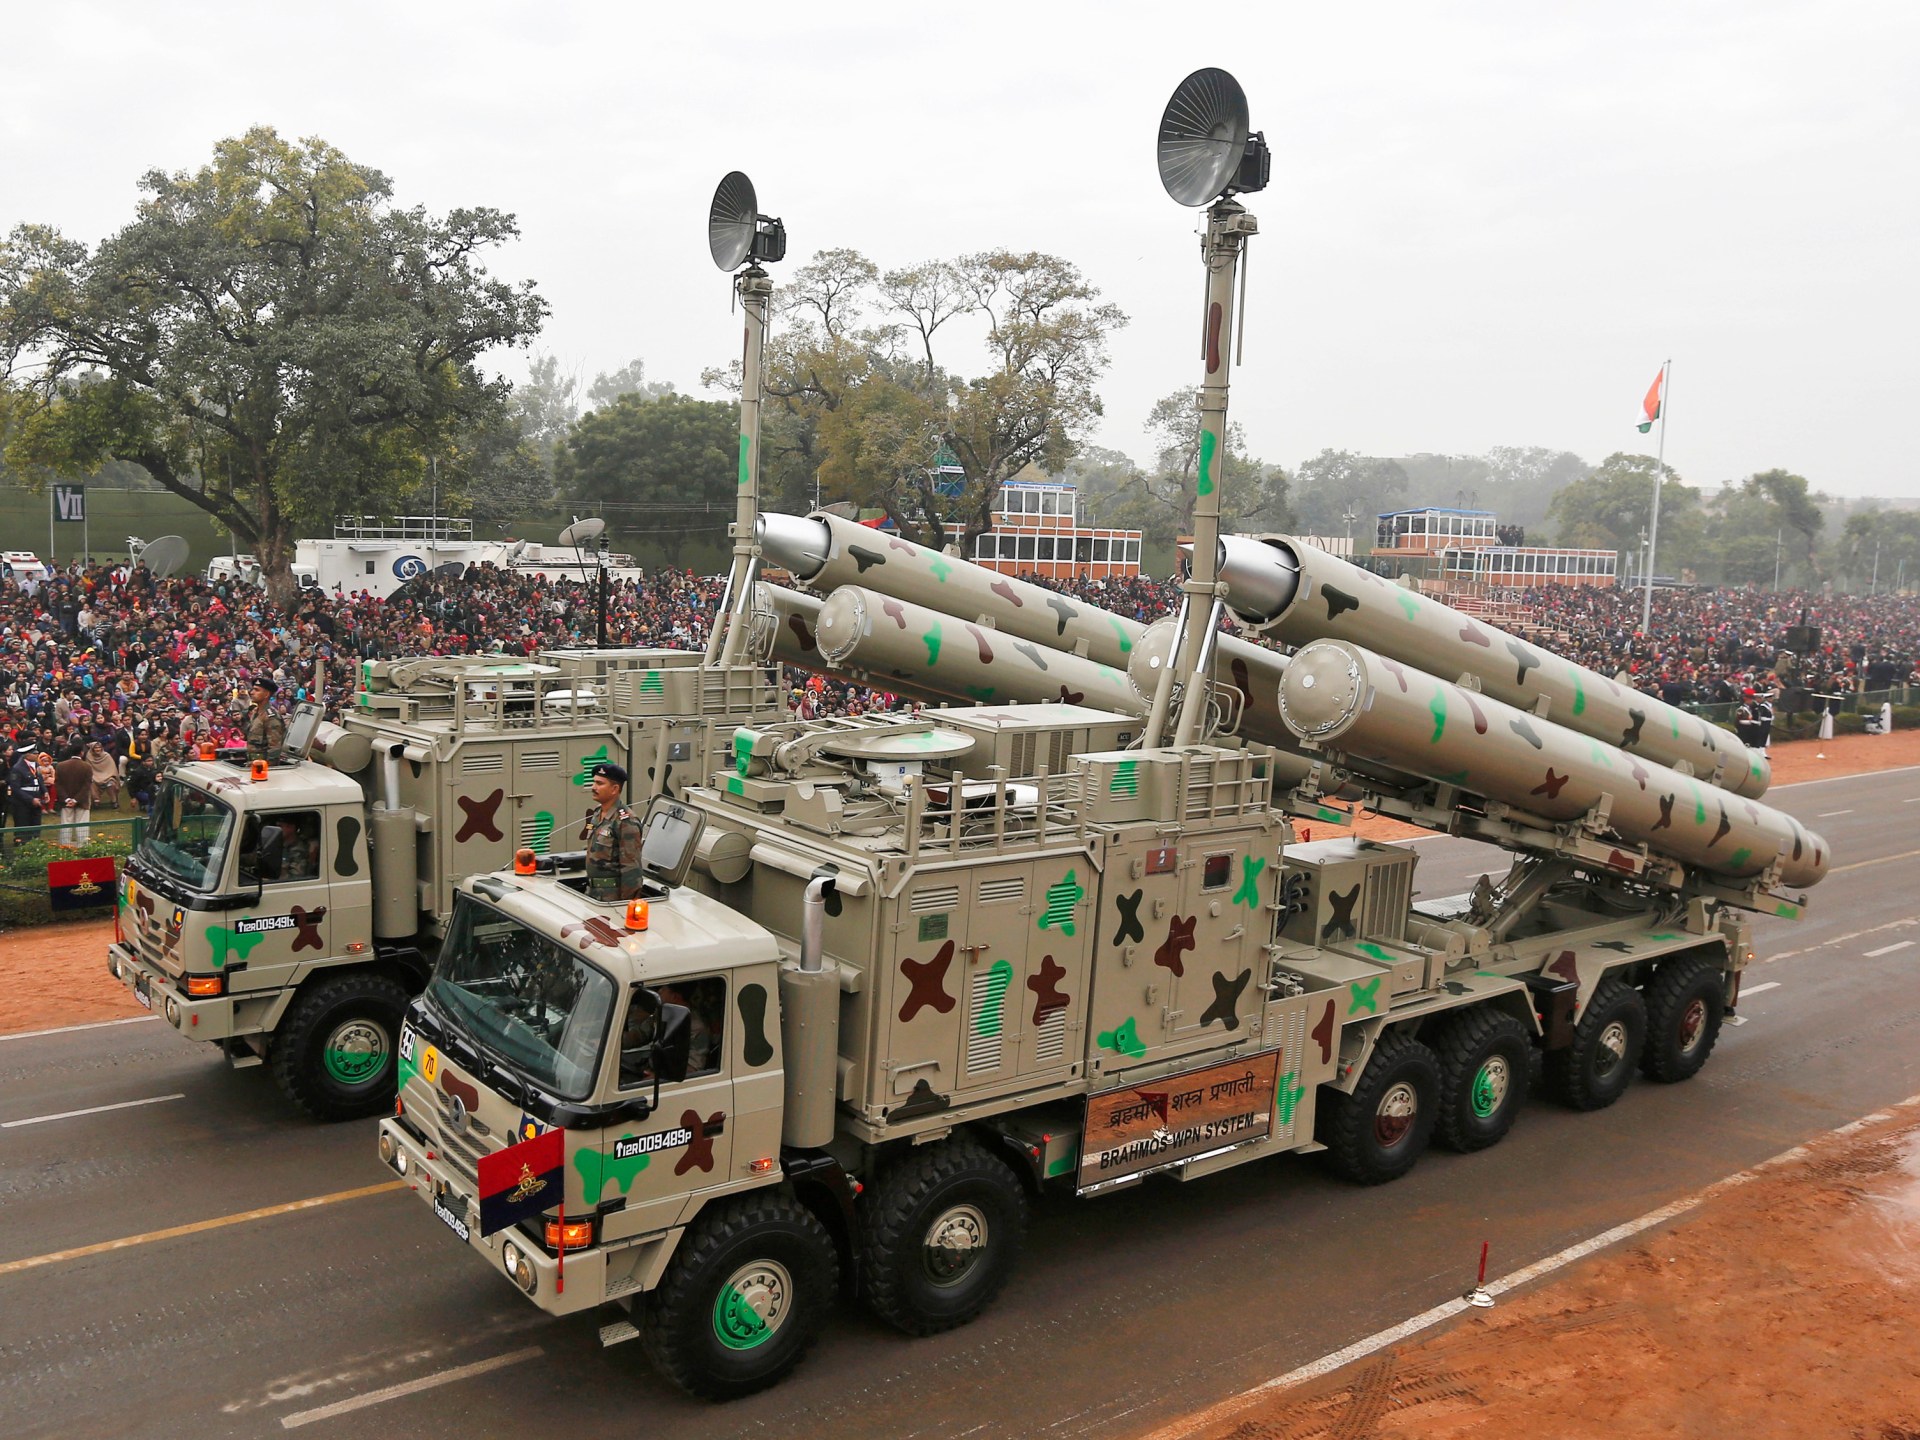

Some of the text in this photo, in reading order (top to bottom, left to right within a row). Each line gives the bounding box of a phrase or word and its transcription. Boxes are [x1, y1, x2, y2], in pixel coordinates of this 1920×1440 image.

[56, 487, 83, 519] VII
[1172, 1088, 1204, 1111] शस्त्र
[1209, 1071, 1255, 1100] प्रणाली
[622, 1129, 692, 1157] 12R009489P
[1100, 1112, 1254, 1169] BRAHMOS WPN SYSTEM
